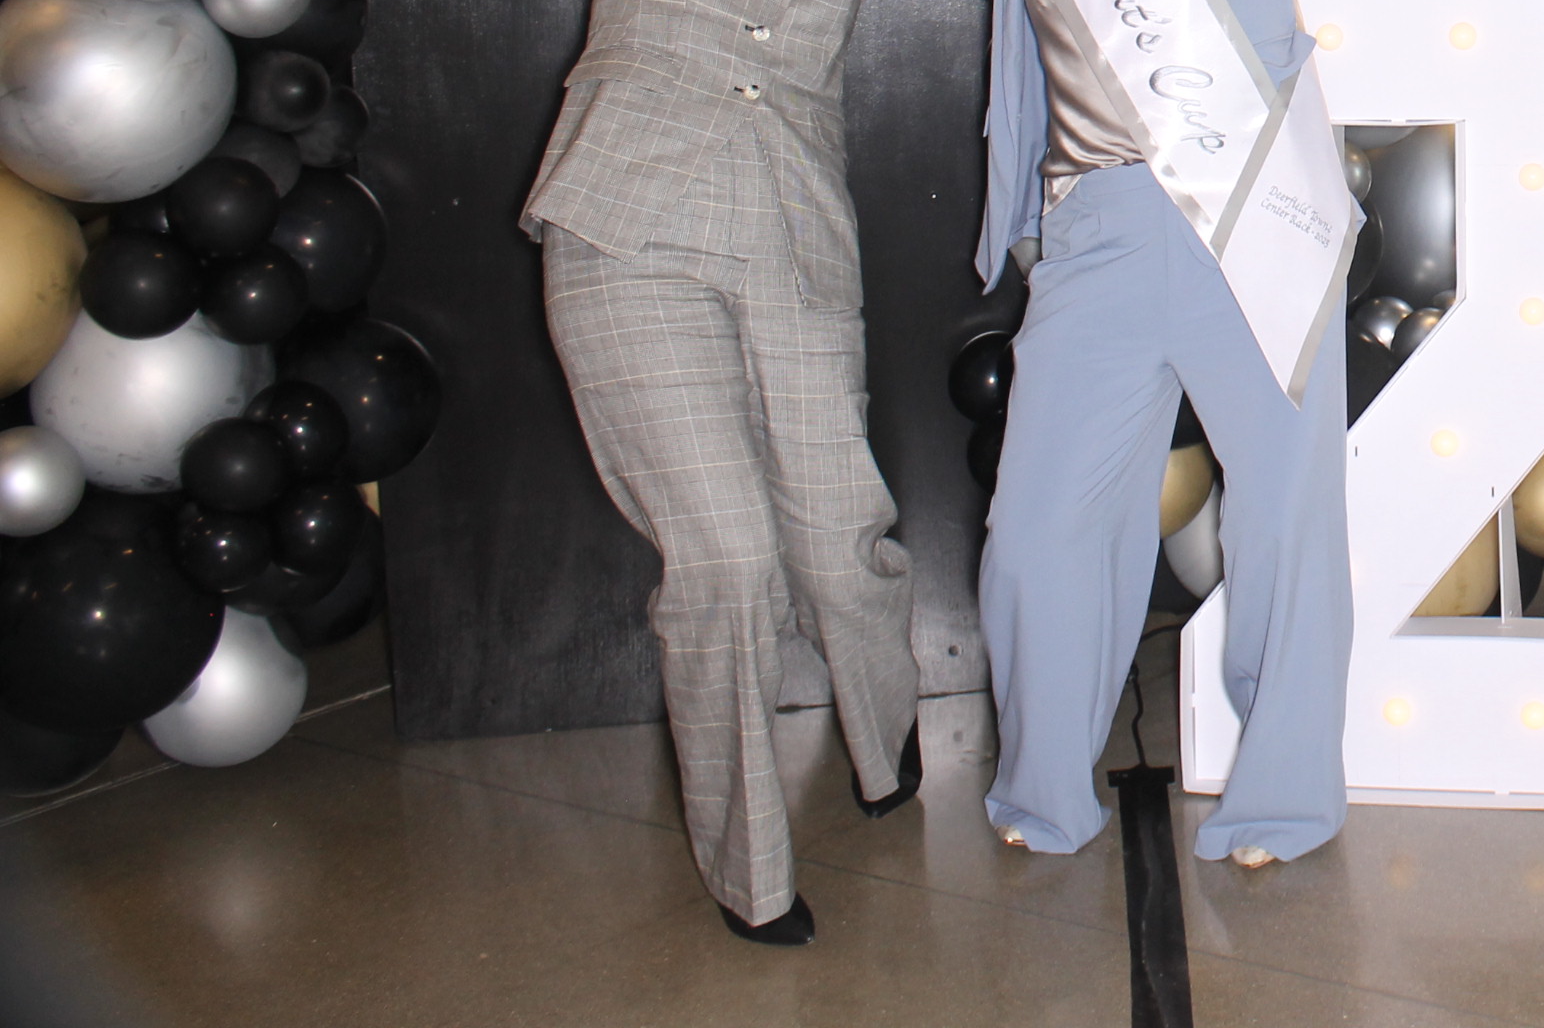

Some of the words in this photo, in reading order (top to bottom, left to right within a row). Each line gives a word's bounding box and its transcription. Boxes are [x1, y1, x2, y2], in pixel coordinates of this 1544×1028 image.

[1149, 65, 1225, 154] Cup
[1260, 197, 1290, 220] Center
[1268, 185, 1312, 216] Deerfield
